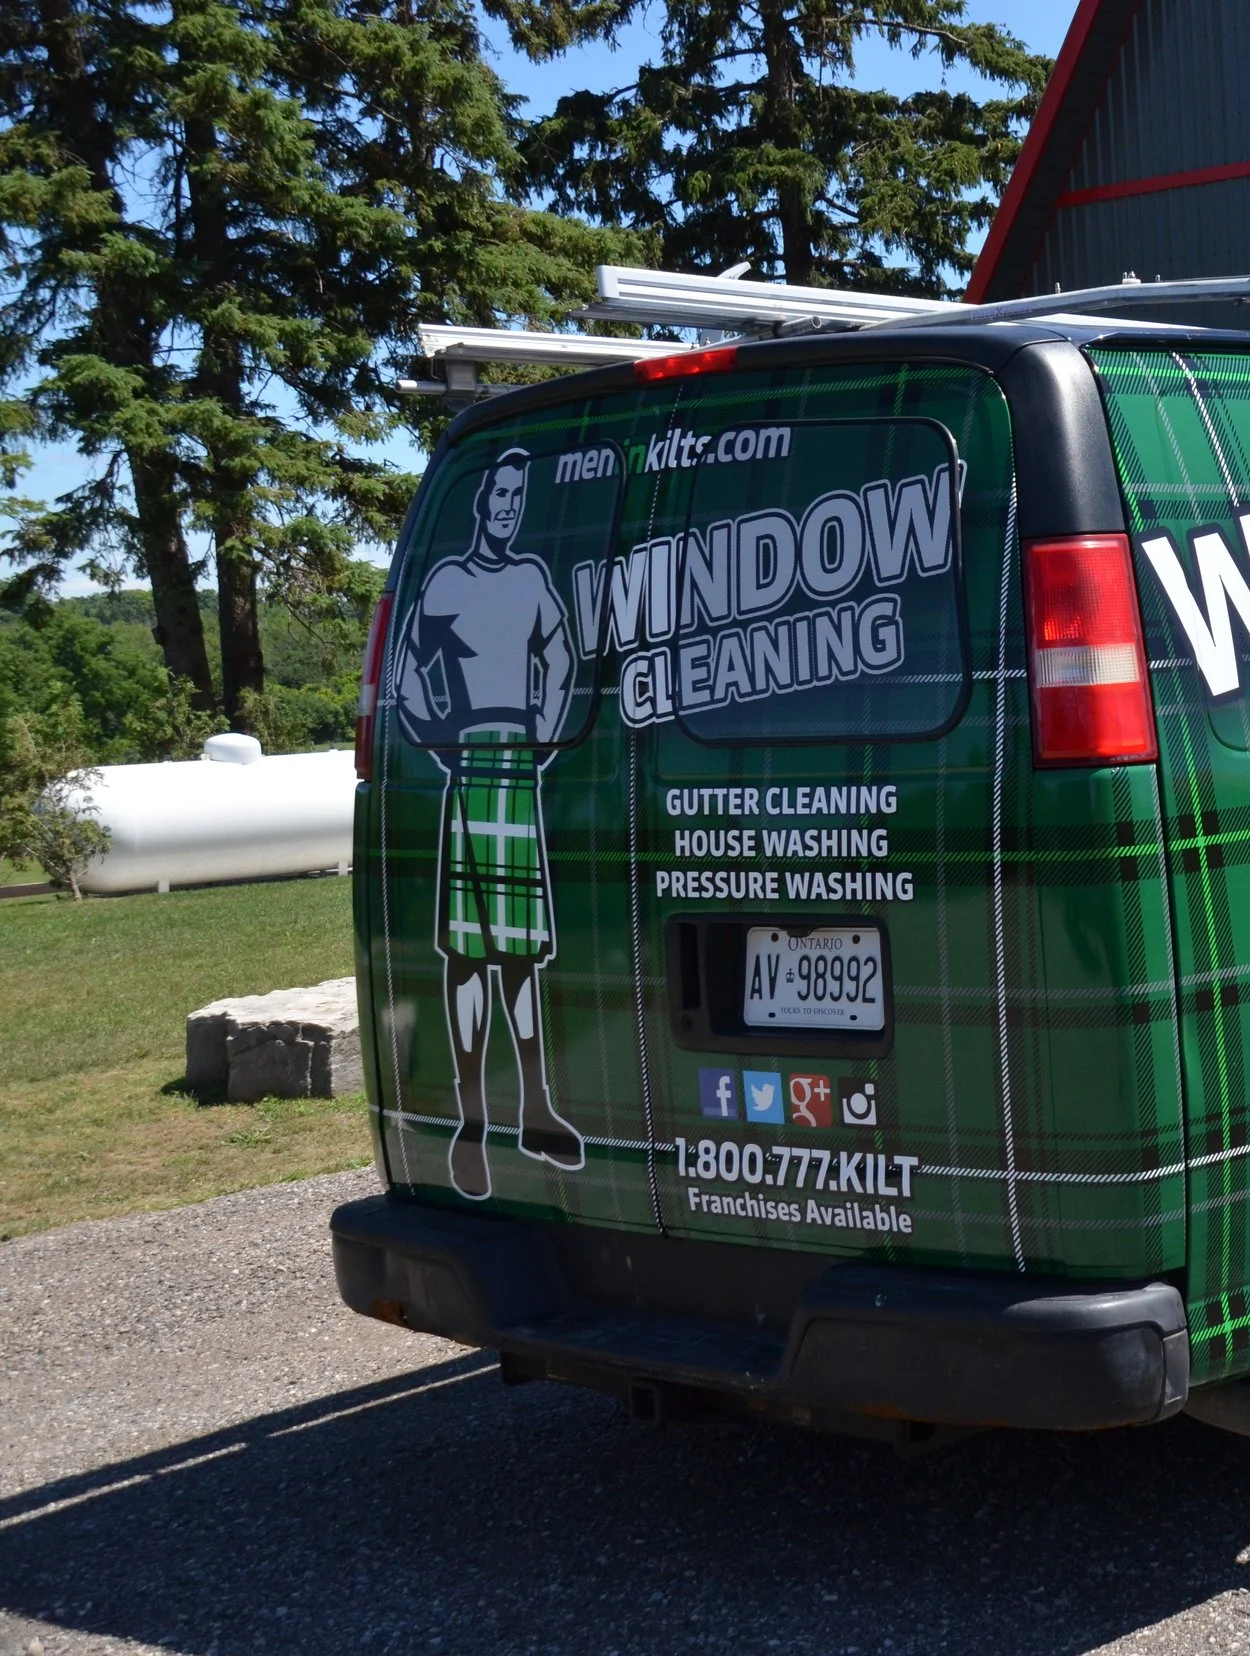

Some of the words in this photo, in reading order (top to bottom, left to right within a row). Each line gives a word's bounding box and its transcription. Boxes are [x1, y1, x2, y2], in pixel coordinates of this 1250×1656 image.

[573, 460, 967, 660] WINDOW
[620, 593, 904, 728] CLEANING
[666, 787, 760, 816] GUTTER
[765, 785, 897, 815] CLEANING
[674, 829, 756, 857] HOUSE
[762, 829, 888, 858] WASHING
[656, 871, 779, 899] PRESSURE
[786, 872, 914, 900] WASHING
[788, 936, 843, 952] ONTARIO
[750, 953, 780, 1000] AV
[797, 954, 878, 1004] 98992
[780, 1007, 801, 1015] YOURS
[803, 1007, 812, 1015] TO
[813, 1007, 845, 1016] DISCOVER
[675, 1136, 919, 1198] 1.800.777.KILT
[687, 1187, 801, 1223] Franchises
[806, 1199, 912, 1234] Available
